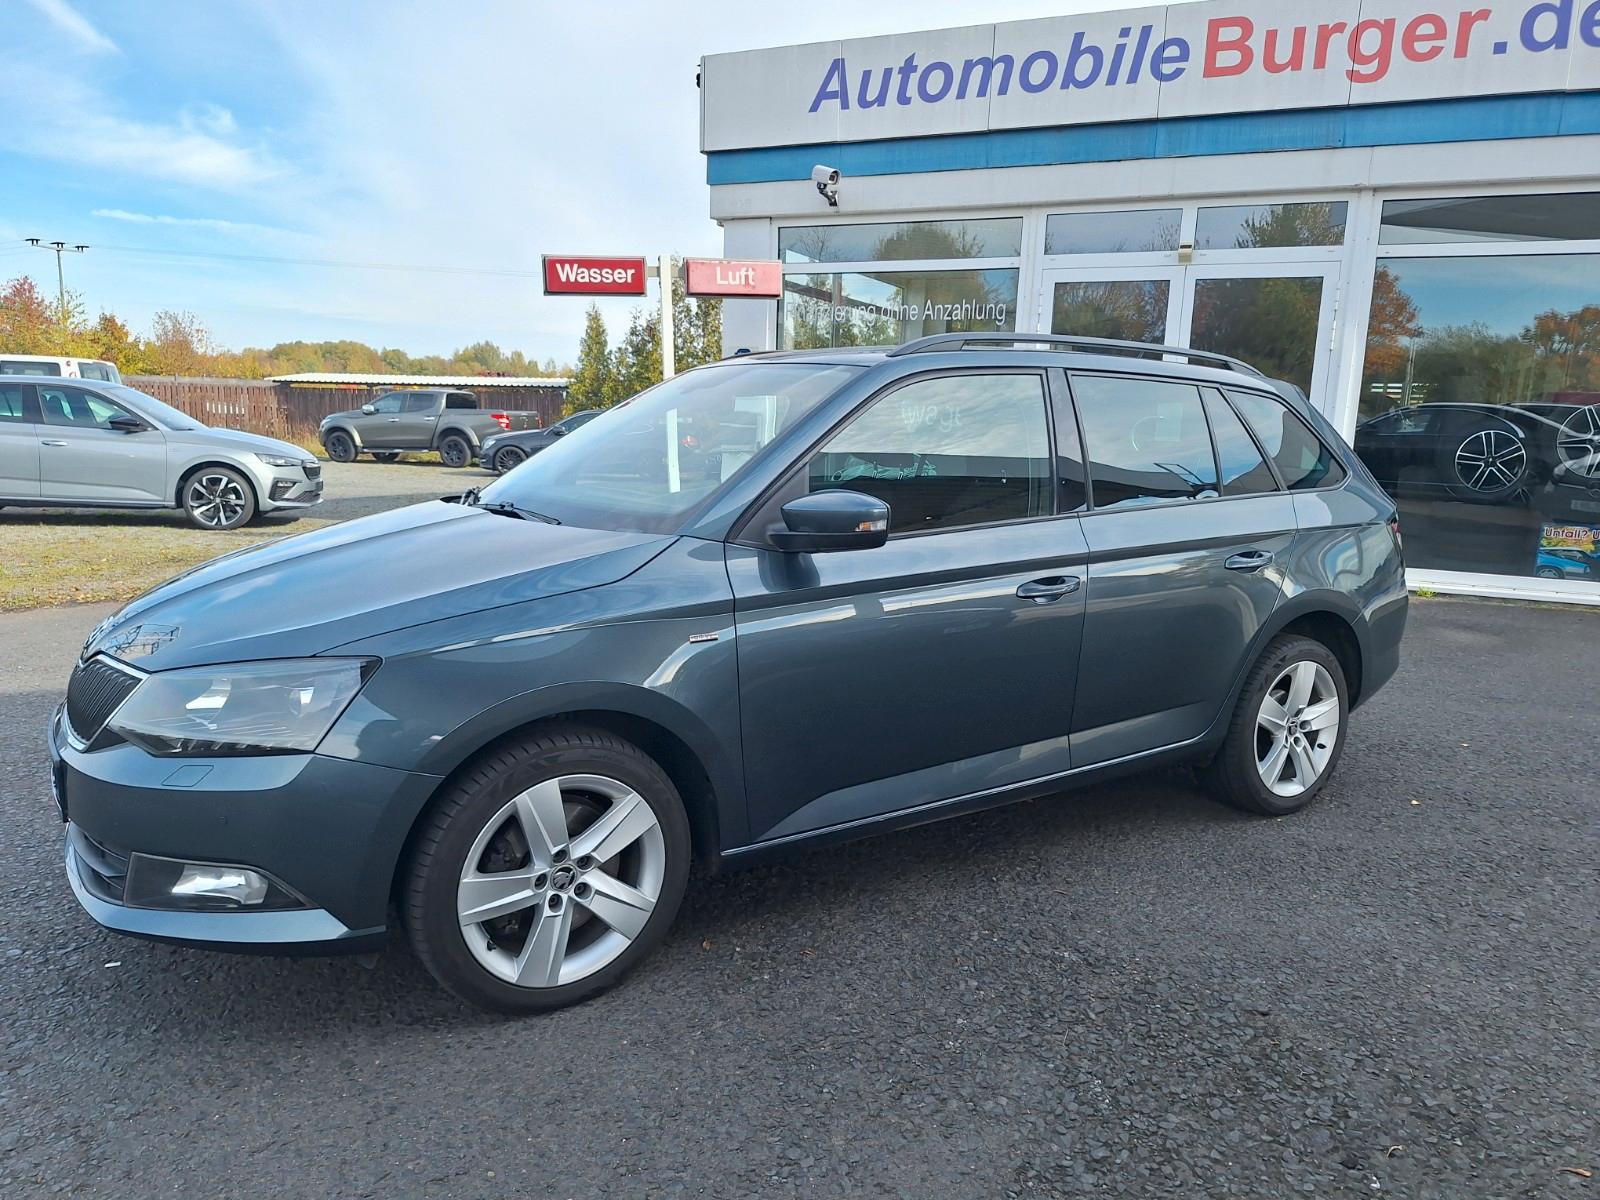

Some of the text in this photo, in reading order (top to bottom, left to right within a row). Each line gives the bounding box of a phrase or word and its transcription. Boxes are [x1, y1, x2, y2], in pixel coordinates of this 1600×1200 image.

[555, 263, 635, 284] Wasser
[715, 265, 756, 286] Luft
[881, 300, 918, 321] ohne
[922, 298, 1006, 326] Anzahlung
[1545, 526, 1588, 540] Unfall?
